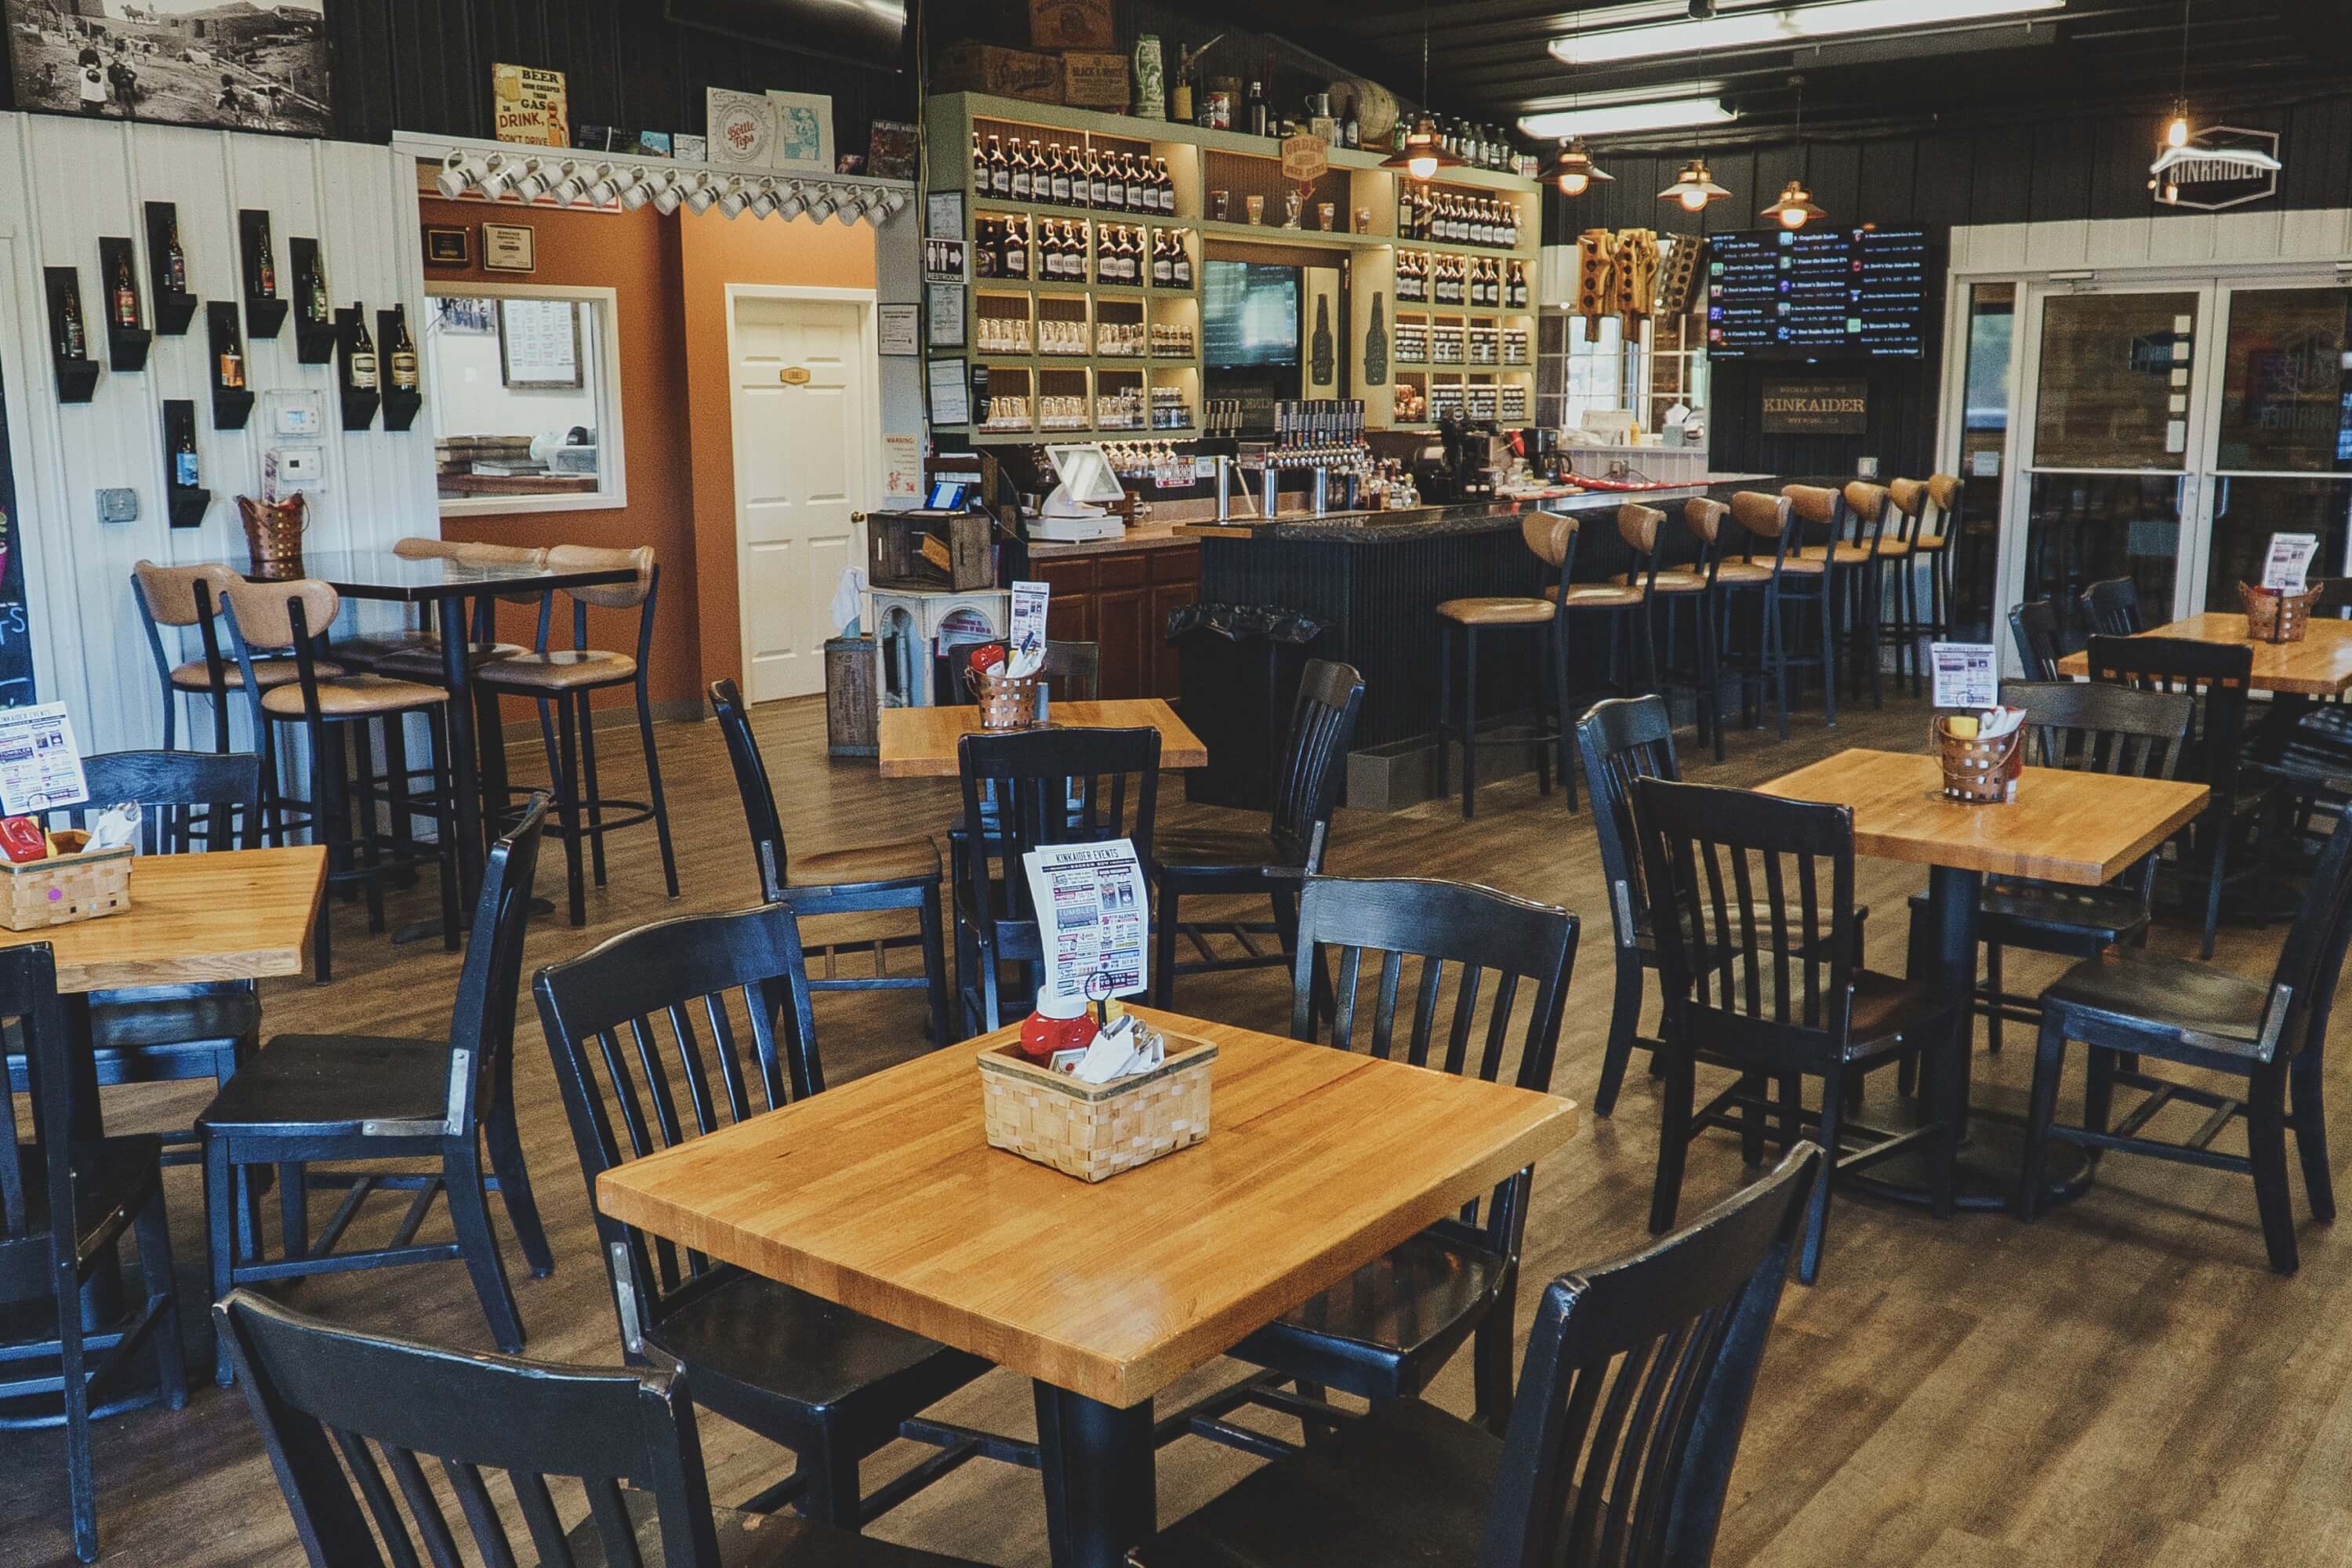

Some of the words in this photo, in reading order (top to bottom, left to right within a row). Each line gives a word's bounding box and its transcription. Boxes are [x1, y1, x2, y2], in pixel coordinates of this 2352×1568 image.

[522, 70, 559, 84] BEER
[521, 99, 546, 111] GAS
[499, 112, 545, 128] DRINK,
[728, 120, 756, 140] Bottle
[525, 136, 549, 147] DRIVE
[732, 134, 755, 150] Tops
[1763, 398, 1865, 413] KINKAIDER
[1055, 851, 1092, 863] KINKAIDER
[1093, 848, 1120, 860] EVENTS
